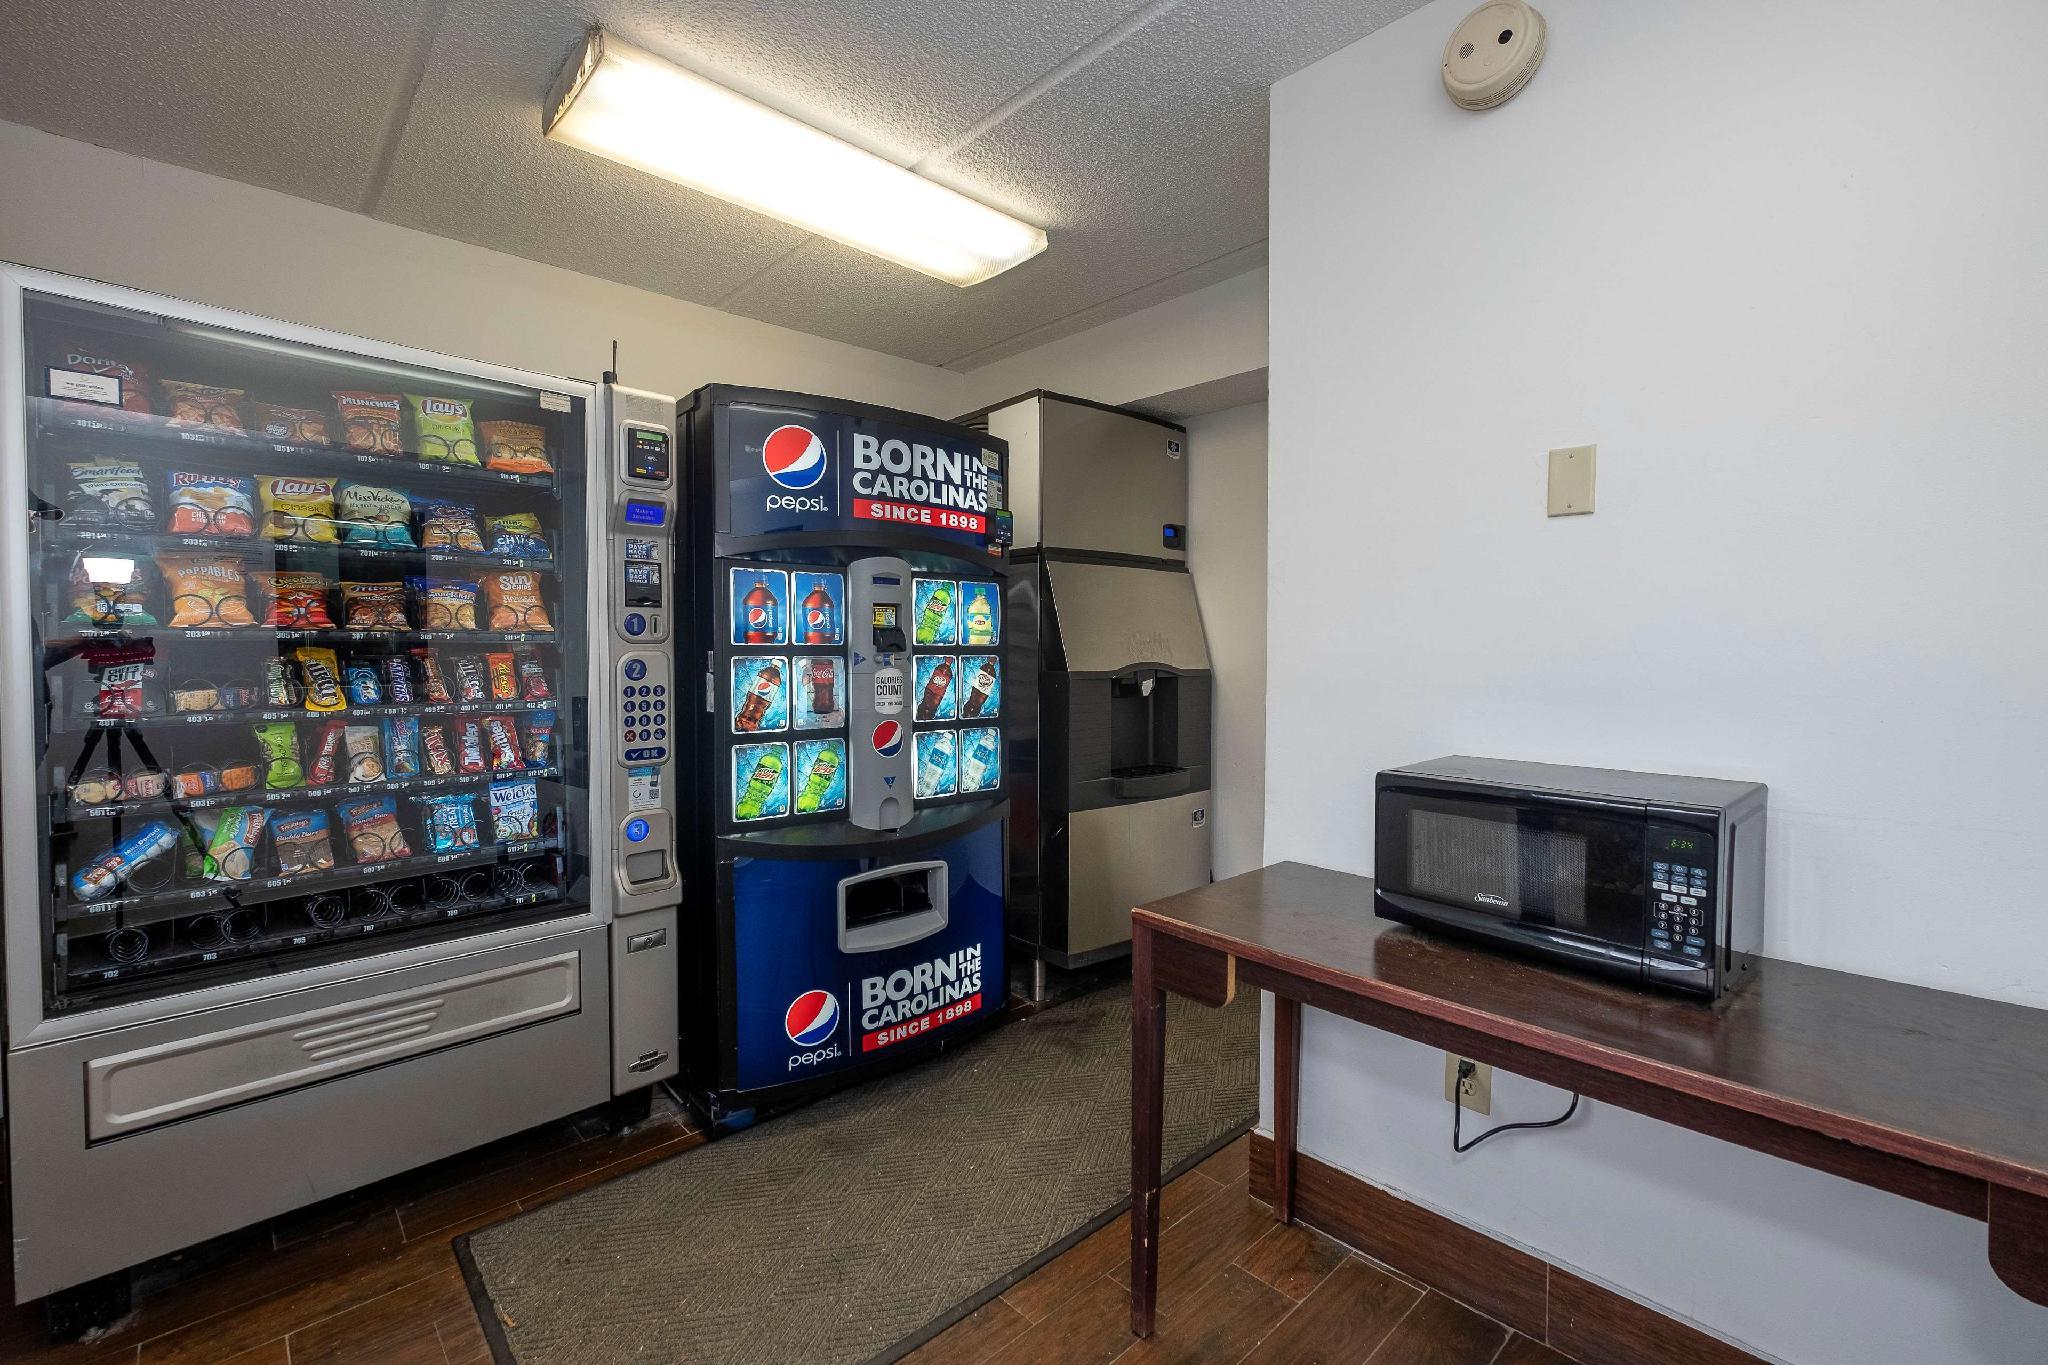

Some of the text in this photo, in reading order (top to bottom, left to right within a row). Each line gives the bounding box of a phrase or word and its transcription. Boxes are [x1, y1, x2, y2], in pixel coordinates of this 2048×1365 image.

[853, 433, 962, 486] BORN
[965, 454, 987, 475] IN
[965, 470, 988, 491] THE
[852, 472, 988, 512] CAROLINAS
[766, 494, 824, 513] pepsi
[871, 503, 978, 530] SINCE 1898
[185, 630, 201, 638] 303
[632, 617, 638, 632] 1
[632, 662, 640, 678] 2
[876, 684, 903, 696] COUNT
[186, 715, 202, 723] 403
[1473, 892, 1509, 907] Sunbeam
[202, 953, 218, 961] 703
[958, 943, 981, 963] IN
[103, 970, 119, 978] 702
[958, 957, 981, 977] THE
[862, 952, 957, 1010] BORN
[861, 972, 982, 1031] CAROLINAS
[877, 1000, 973, 1046] SINCE 1898
[788, 1043, 838, 1071] pepsi
